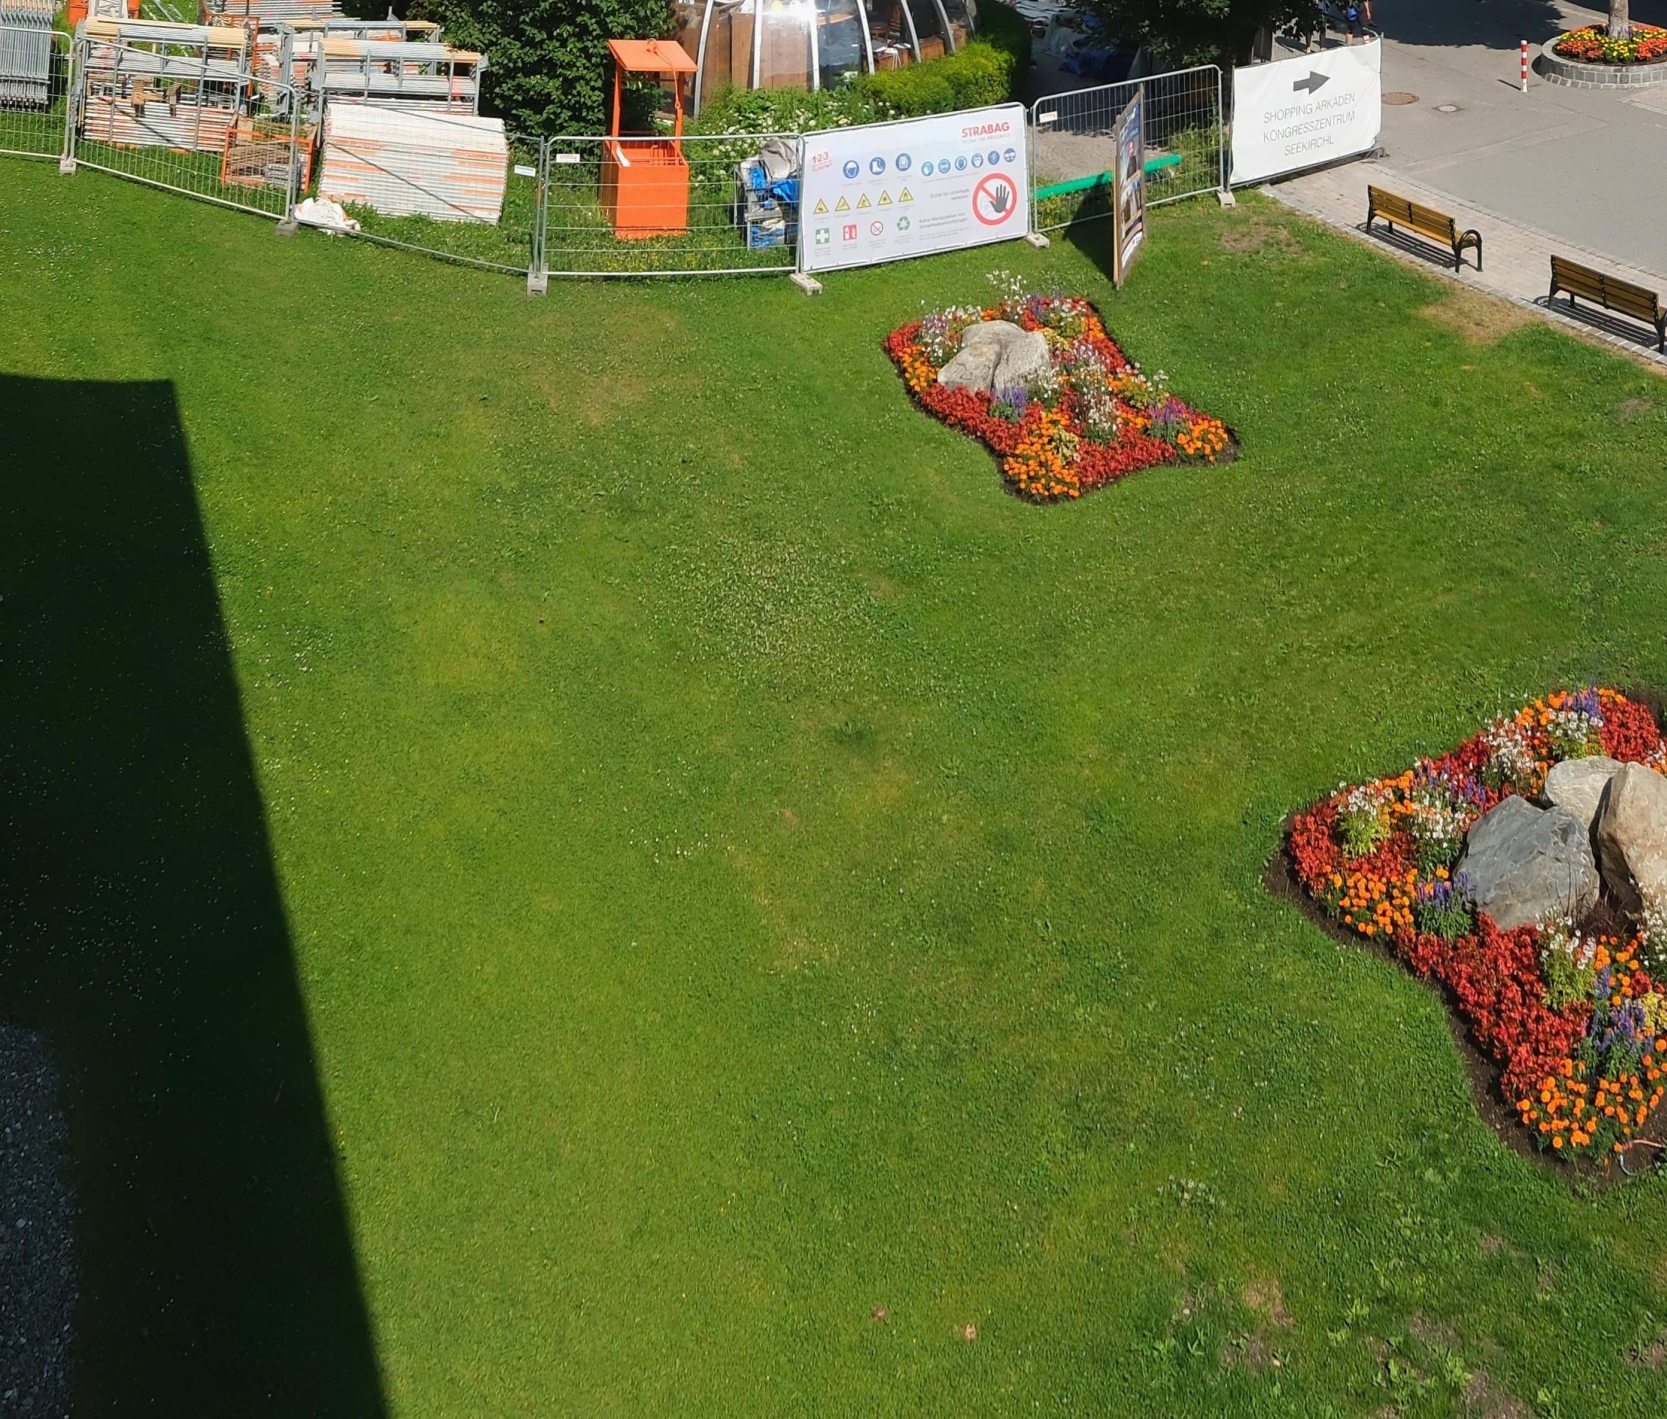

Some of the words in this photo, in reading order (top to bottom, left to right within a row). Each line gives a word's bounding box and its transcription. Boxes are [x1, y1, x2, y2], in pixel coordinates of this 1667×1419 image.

[1263, 103, 1314, 125] SHOPPING
[1315, 92, 1356, 112] ARKADEN
[961, 122, 1010, 138] STRABAG
[1263, 110, 1356, 143] KONGRESSZENTRUM
[1284, 134, 1335, 157] SEEKIRCHL
